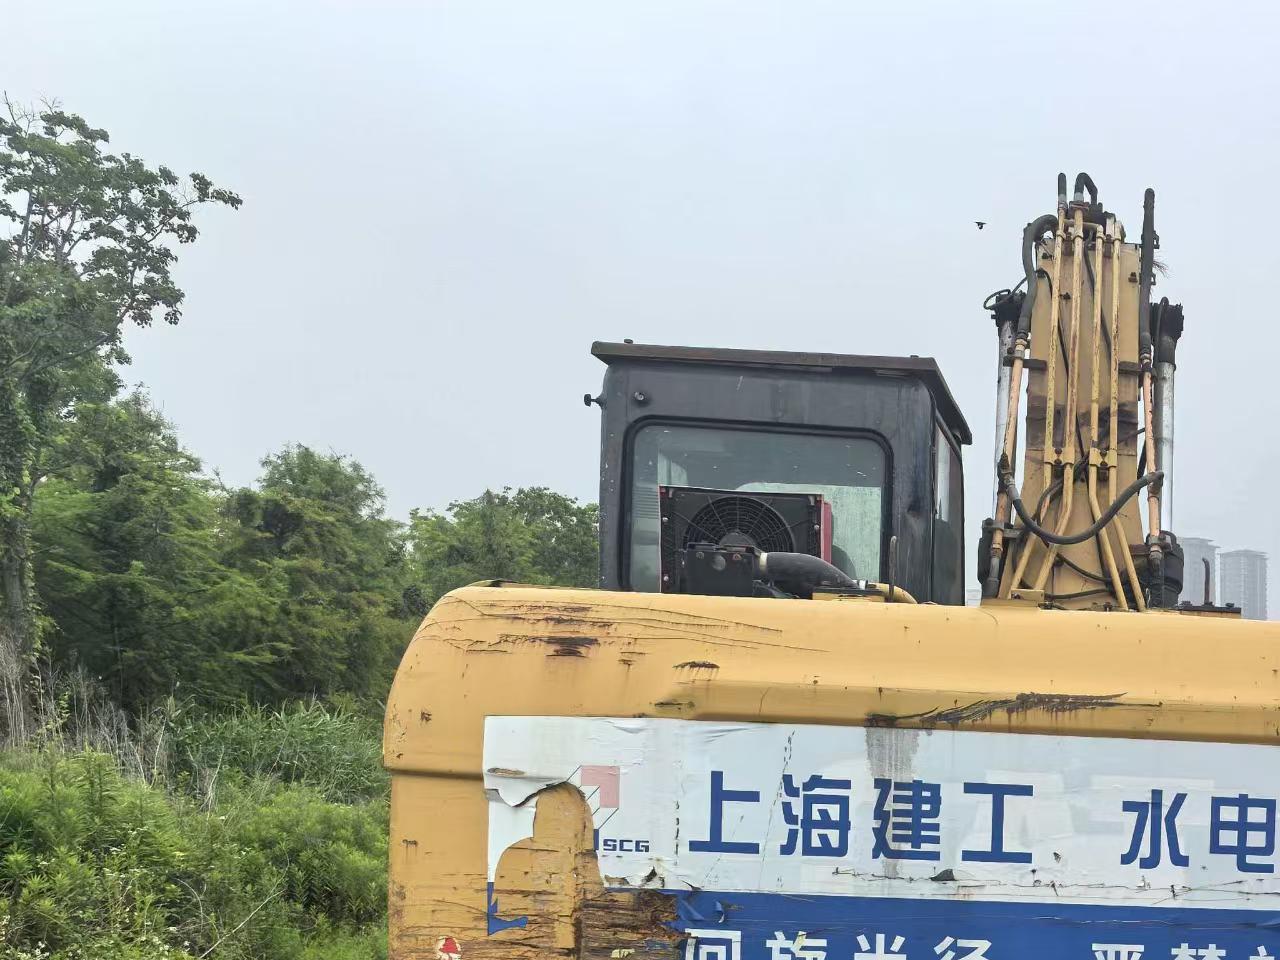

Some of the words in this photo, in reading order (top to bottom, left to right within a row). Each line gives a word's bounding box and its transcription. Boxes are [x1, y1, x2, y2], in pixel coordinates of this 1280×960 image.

[689, 771, 1033, 864] 上海建工
[603, 839, 649, 852] SCG
